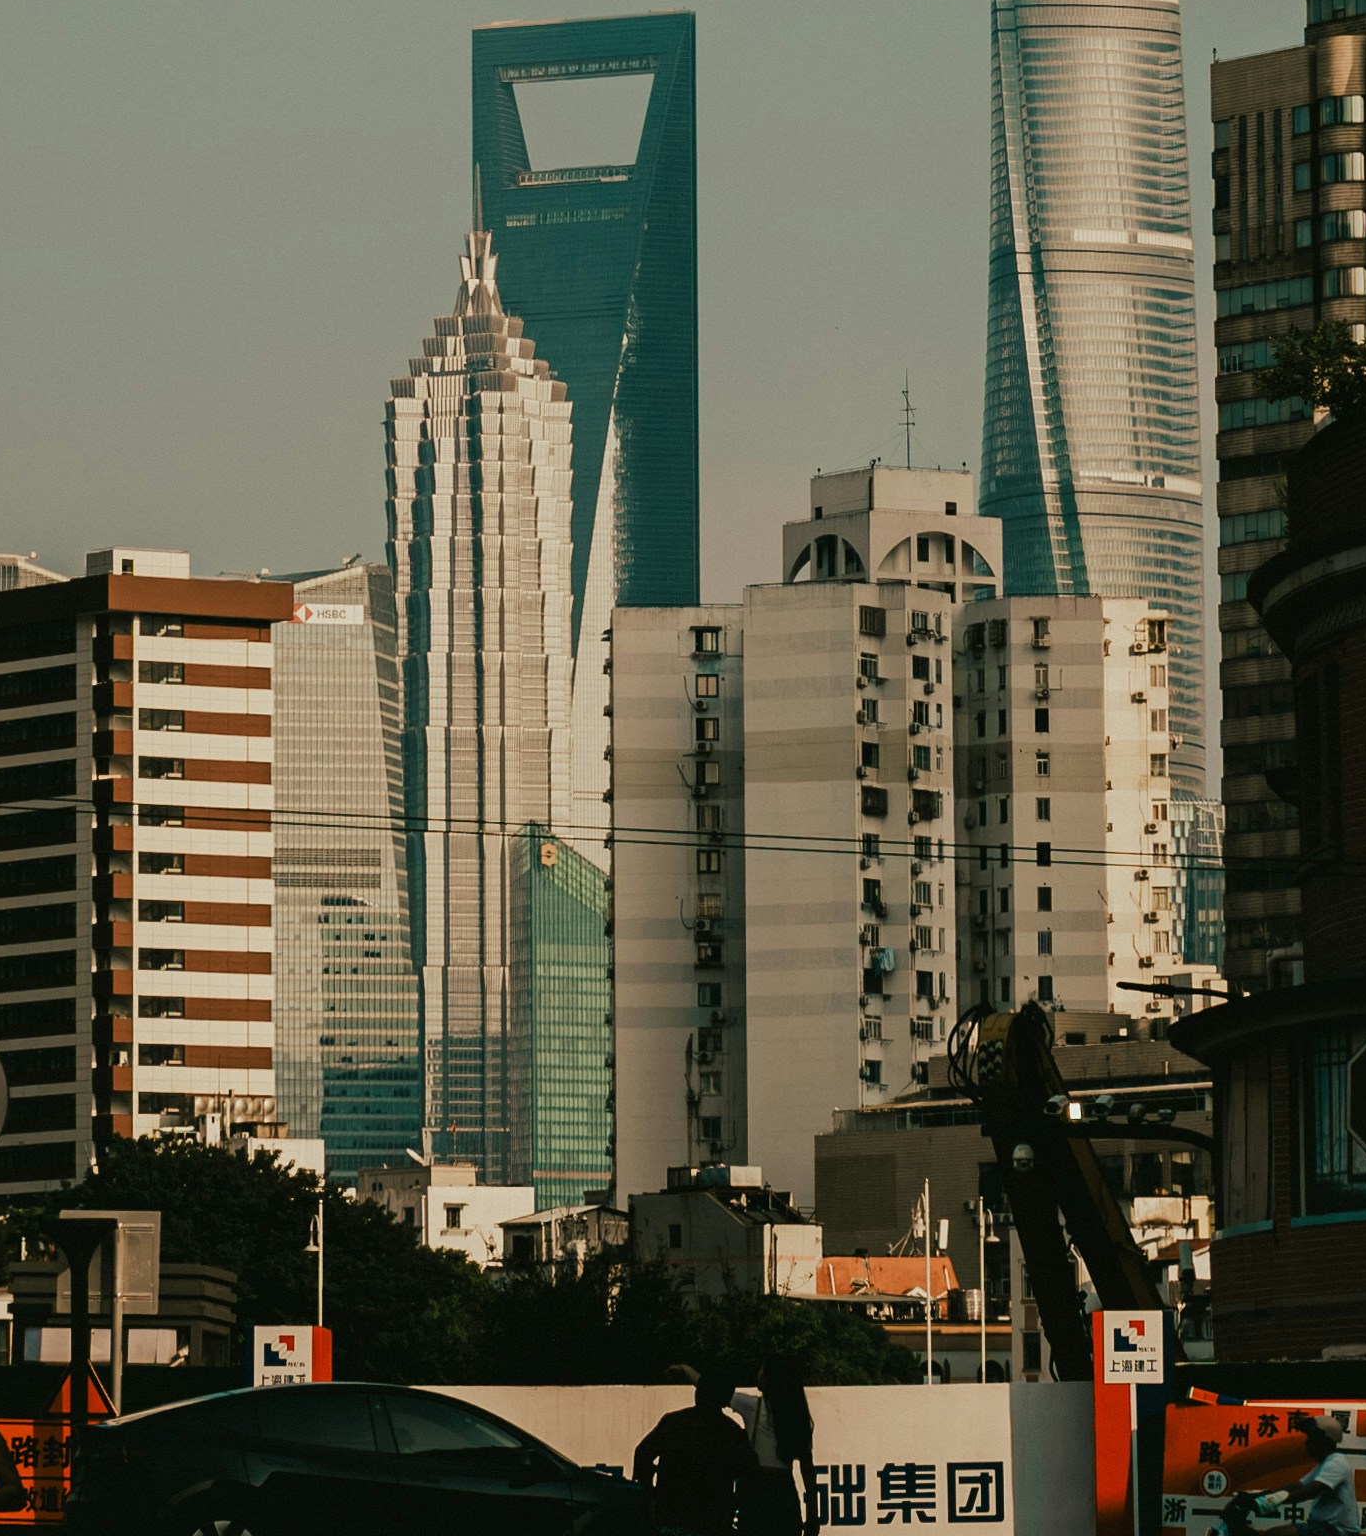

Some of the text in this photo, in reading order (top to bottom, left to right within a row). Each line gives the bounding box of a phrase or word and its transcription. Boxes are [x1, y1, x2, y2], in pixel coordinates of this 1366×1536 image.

[317, 609, 346, 619] HSBC
[1109, 1360, 1157, 1372] 上海建工
